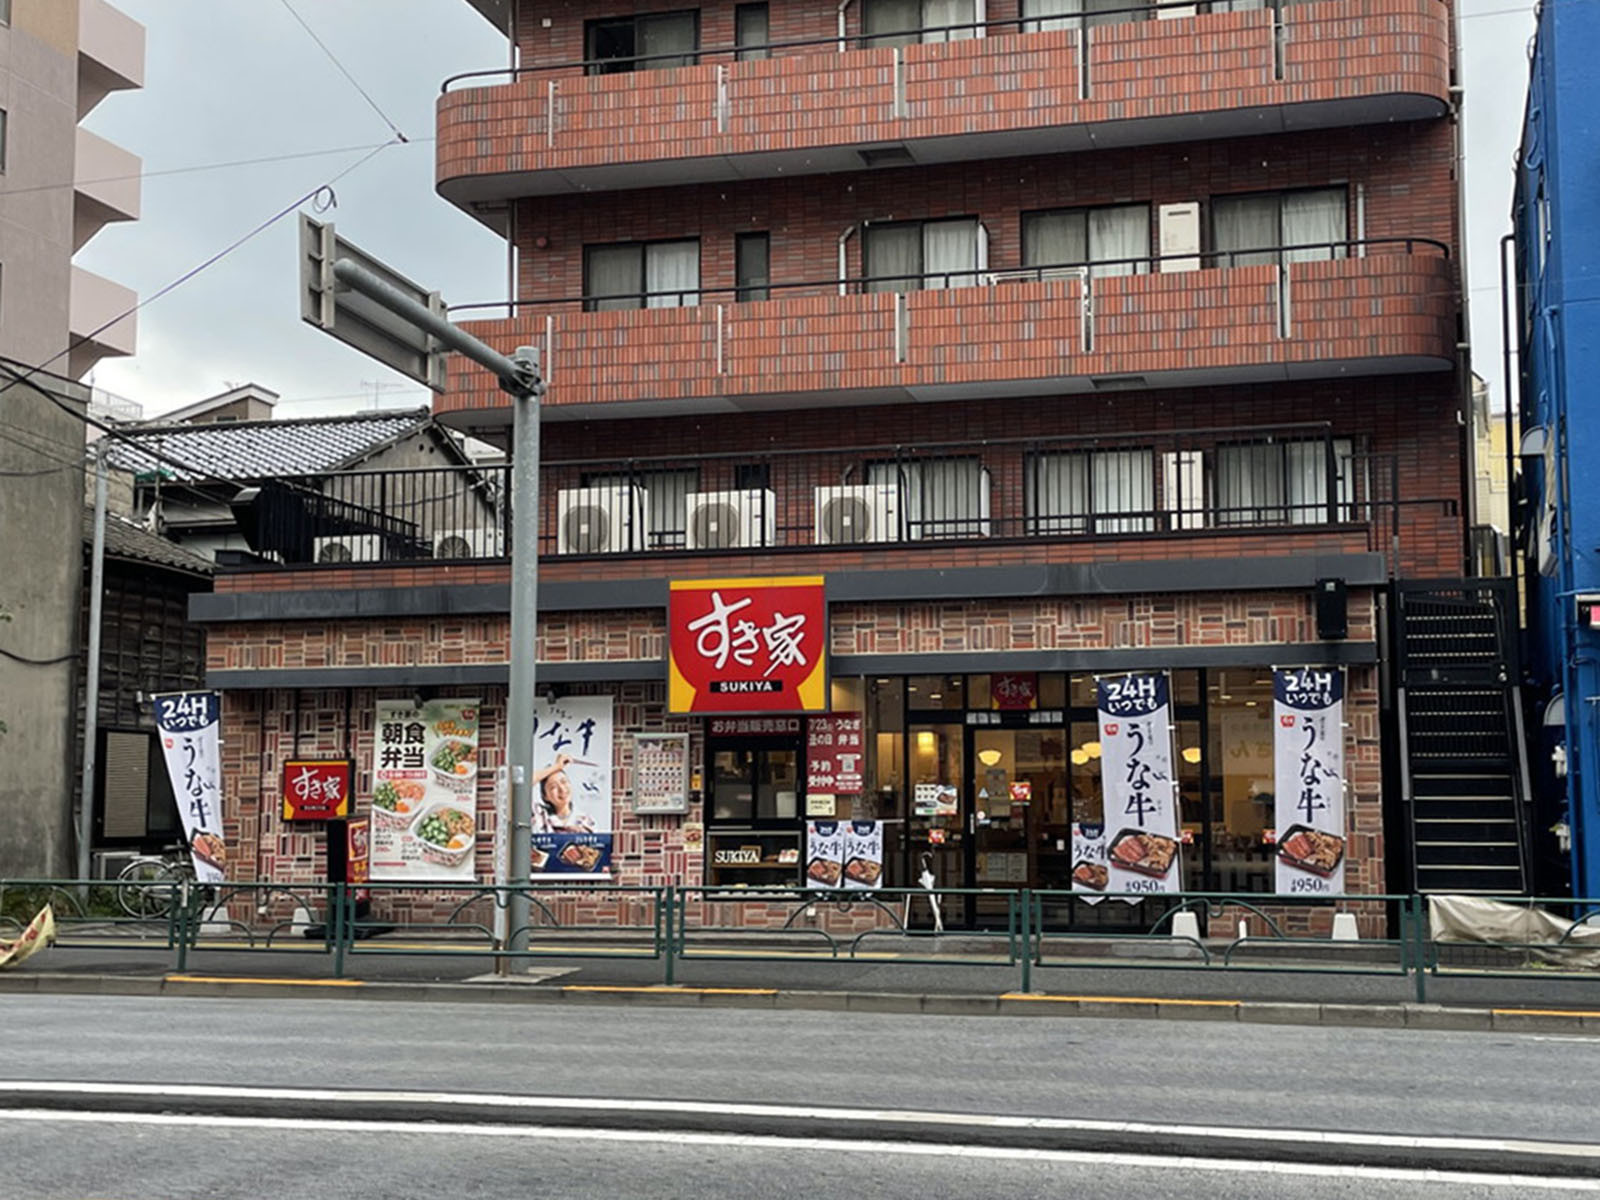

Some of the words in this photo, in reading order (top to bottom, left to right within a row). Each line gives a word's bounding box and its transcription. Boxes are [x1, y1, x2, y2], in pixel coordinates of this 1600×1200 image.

[688, 591, 807, 677] すき家
[720, 681, 773, 692] SUKIYA
[1107, 677, 1155, 700] 24H
[1284, 671, 1332, 691] 24H
[162, 696, 207, 718] 24H
[1108, 698, 1157, 713] いつでも
[1286, 692, 1332, 705] いつでも
[163, 715, 209, 729] いつでも
[533, 709, 596, 756] な牛
[382, 722, 426, 745] 朝食
[381, 746, 425, 769] 弁当
[1124, 723, 1157, 827] うな牛
[1297, 717, 1326, 824] うな牛
[183, 737, 211, 828] うな牛
[292, 766, 341, 804] すき家
[715, 850, 760, 863] SUKIYA
[810, 840, 840, 856] うな牛
[847, 840, 877, 856] うな牛
